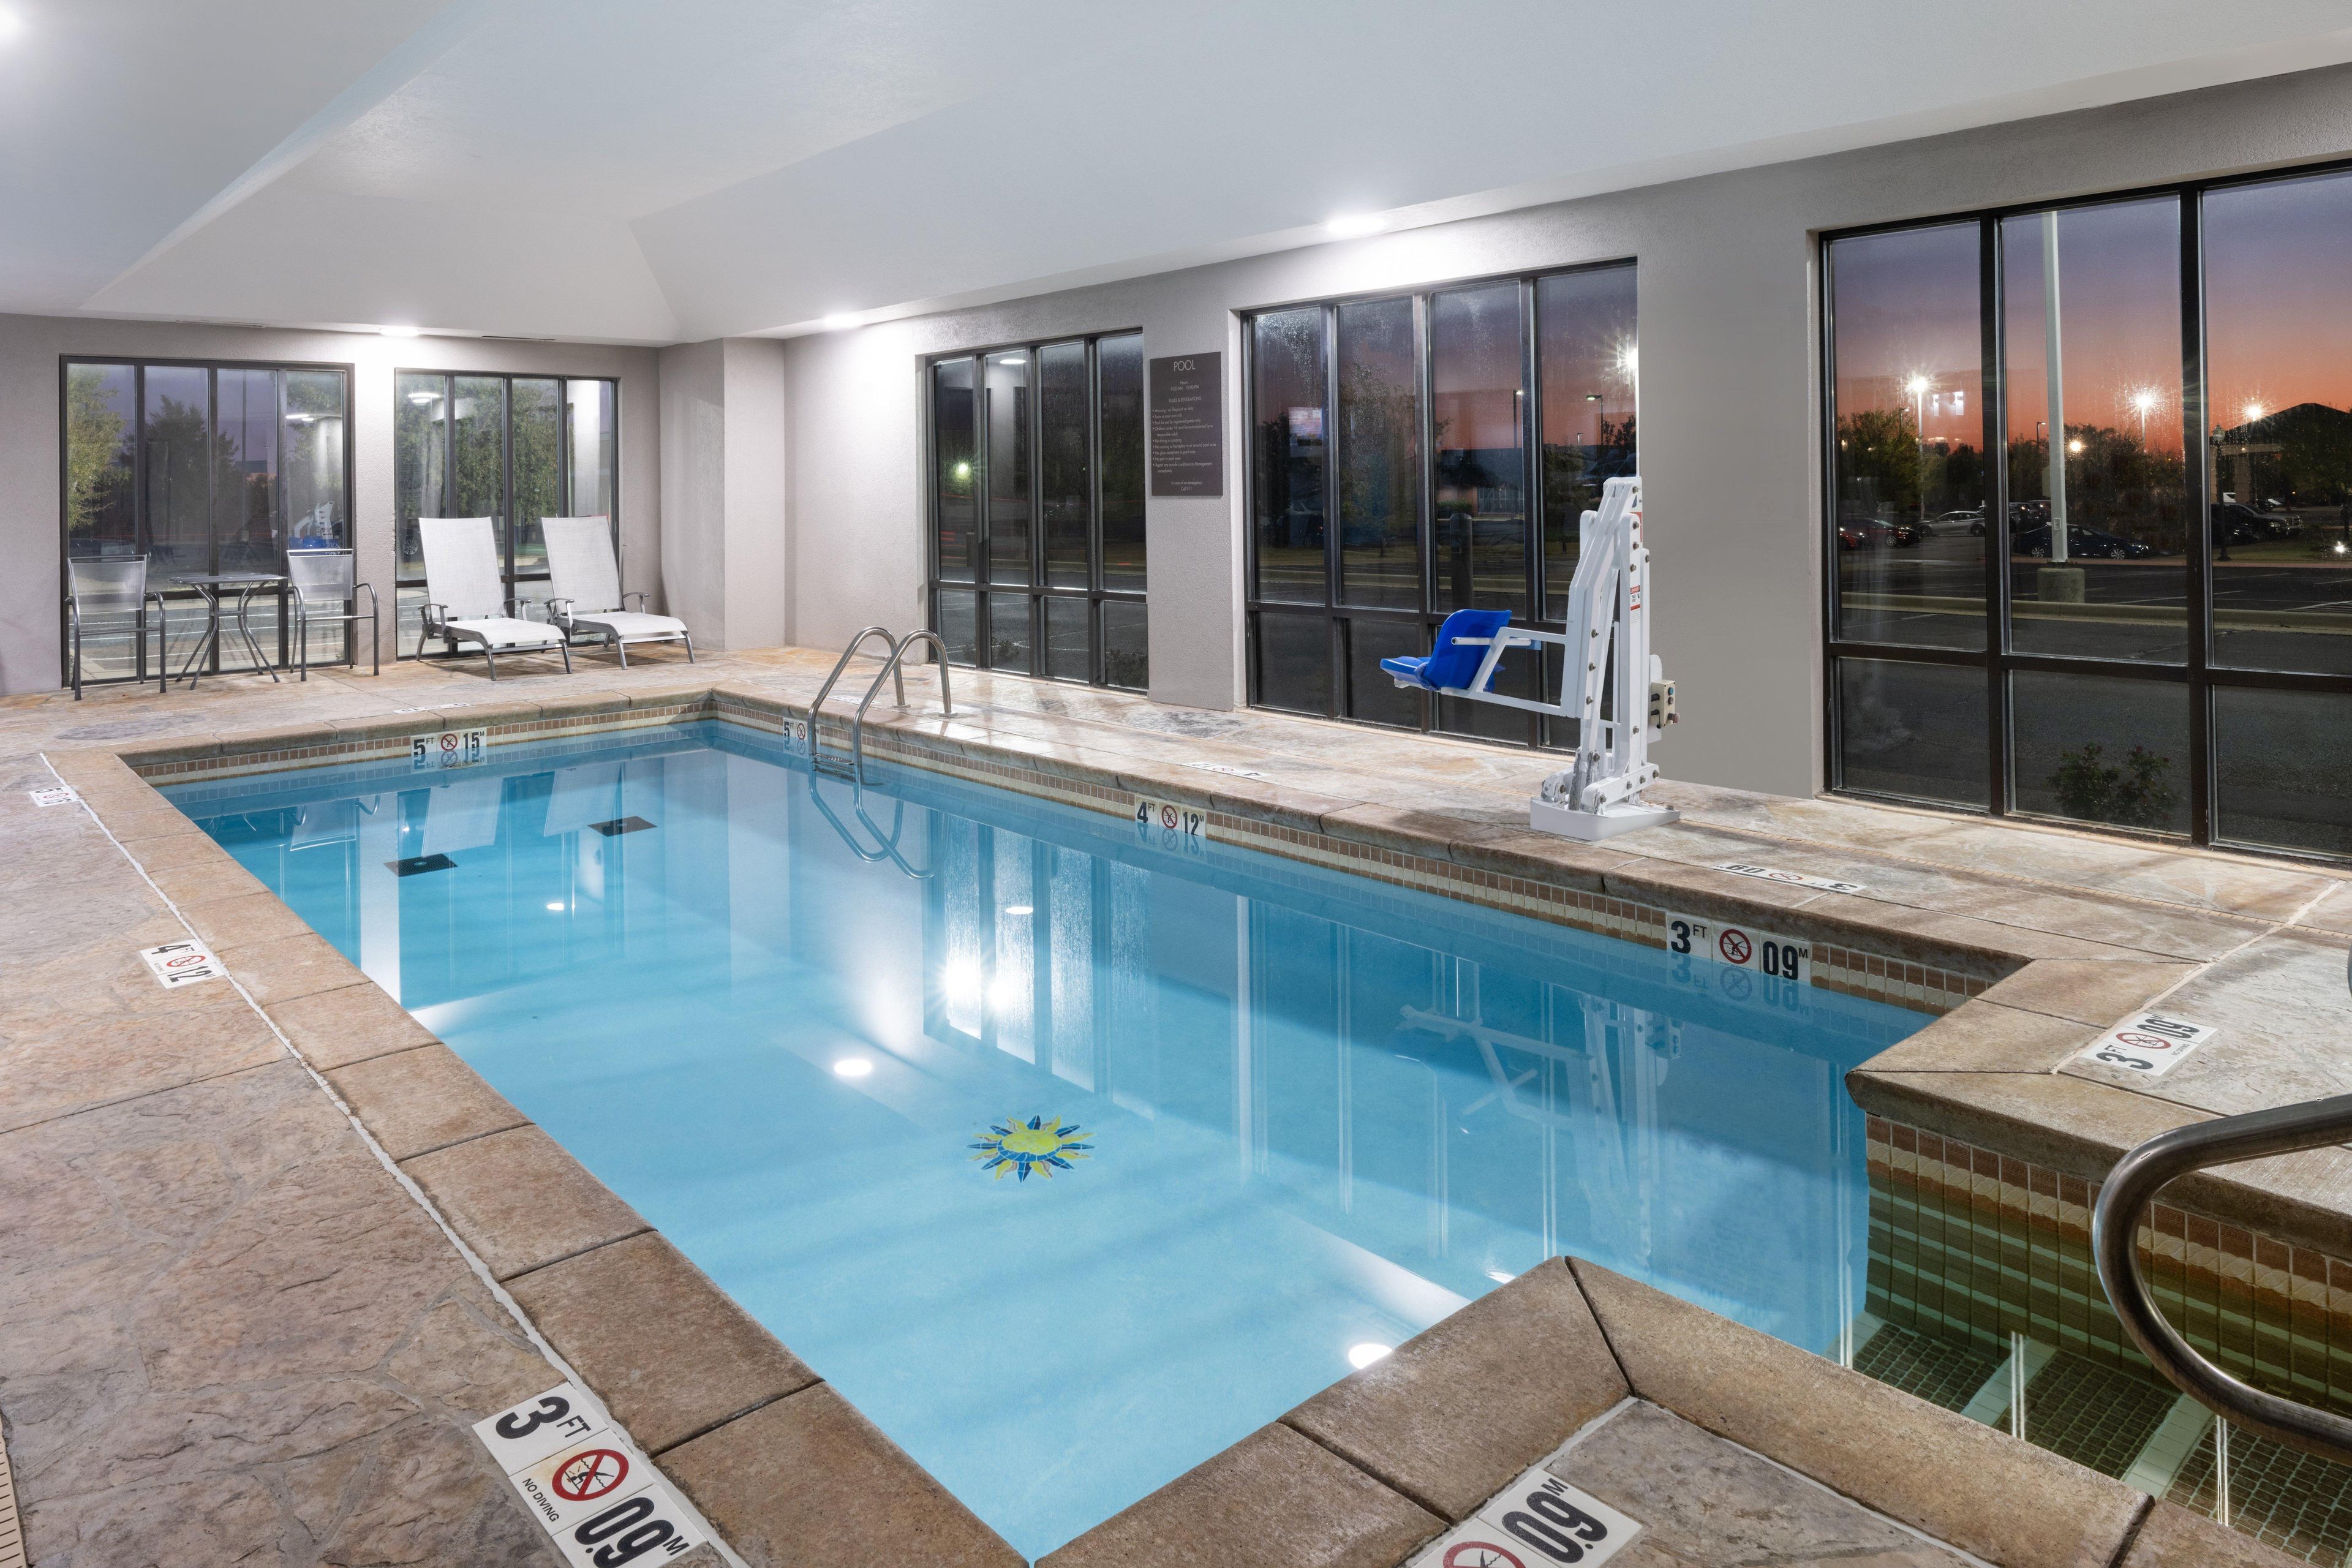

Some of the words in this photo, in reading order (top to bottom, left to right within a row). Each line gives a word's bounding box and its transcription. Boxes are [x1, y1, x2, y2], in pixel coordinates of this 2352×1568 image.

[1174, 360, 1196, 372] POOL
[783, 721, 790, 737] 5
[413, 739, 426, 755] 5
[1137, 801, 1148, 823] 4
[1148, 802, 1155, 812] FT
[1670, 920, 1691, 954] 3
[1693, 924, 1707, 938] FT
[1798, 947, 1808, 959] M
[151, 944, 191, 954] 4
[2108, 1044, 2127, 1054] FT
[2096, 1052, 2154, 1070] 3
[496, 1396, 570, 1440] 3
[556, 1414, 592, 1438] FT
[662, 1535, 690, 1556] M
[1540, 1478, 1569, 1496] M
[522, 1477, 536, 1493] NO
[532, 1491, 560, 1523] DIVING
[1501, 1491, 1608, 1564] 0.9
